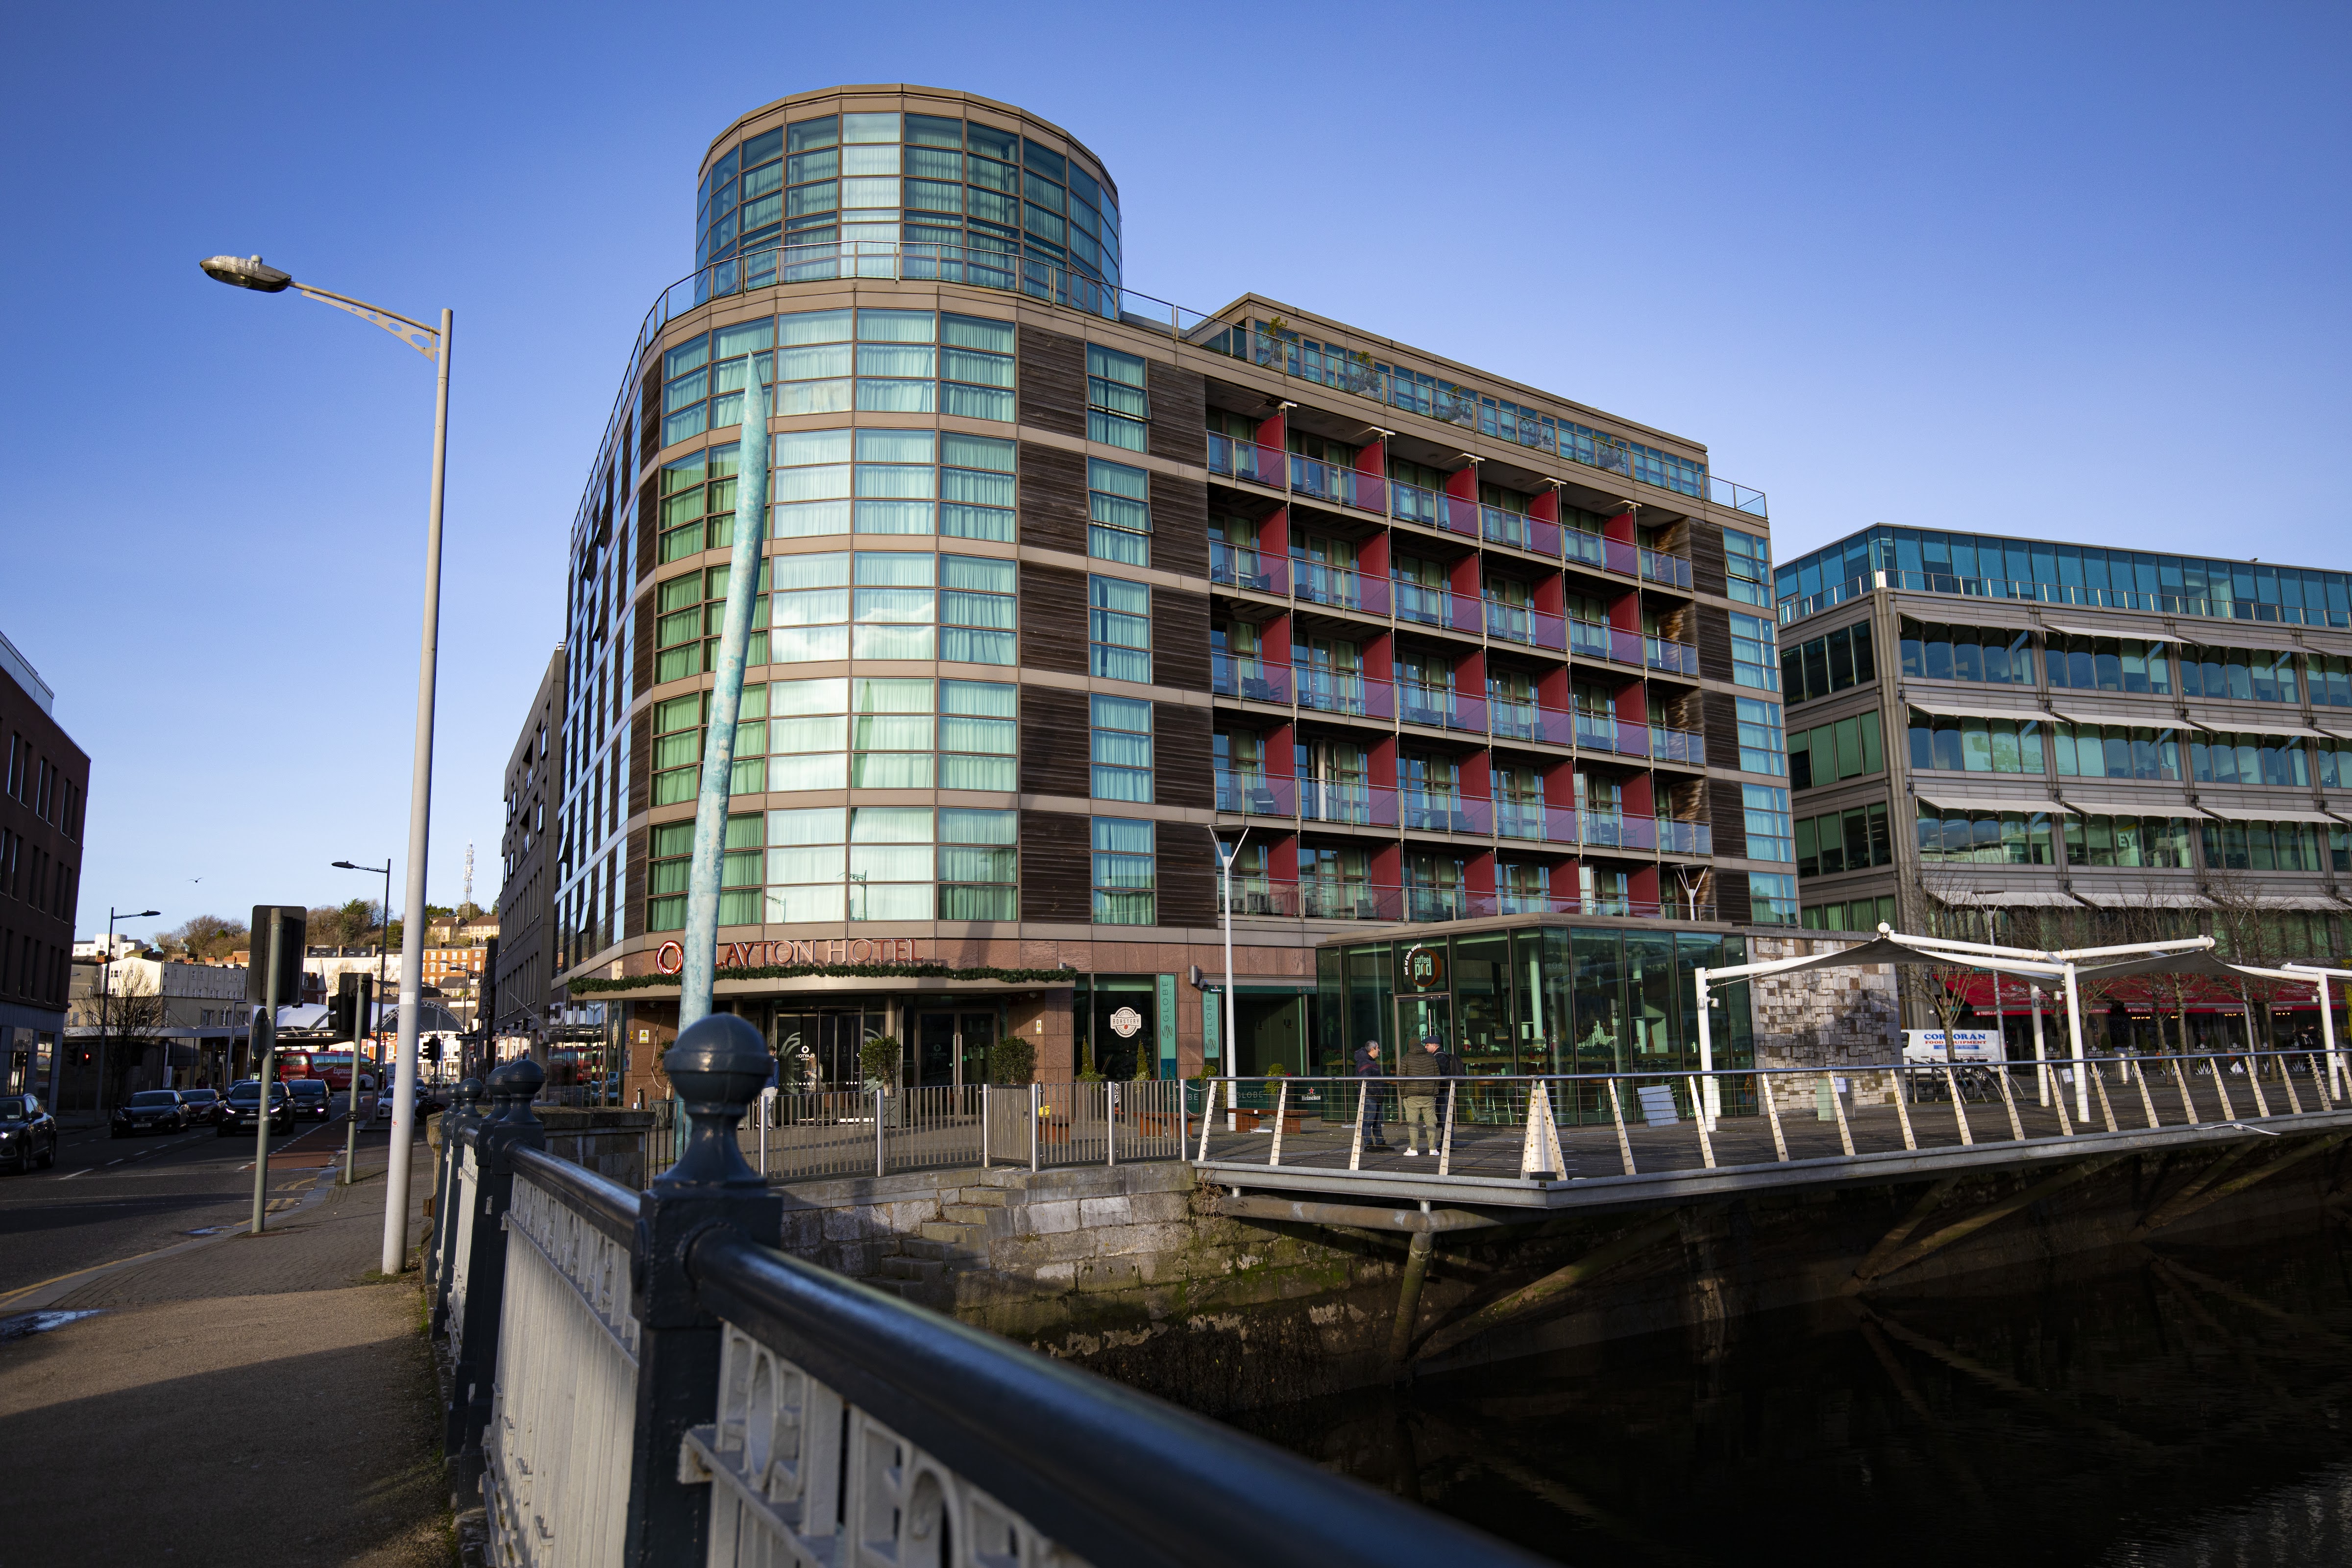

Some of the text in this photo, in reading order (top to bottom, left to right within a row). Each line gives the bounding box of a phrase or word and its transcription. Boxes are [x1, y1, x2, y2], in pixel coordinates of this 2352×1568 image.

[1411, 943, 1421, 952] world
[714, 939, 924, 967] LAYTON HOTEL
[1415, 955, 1429, 964] coffee
